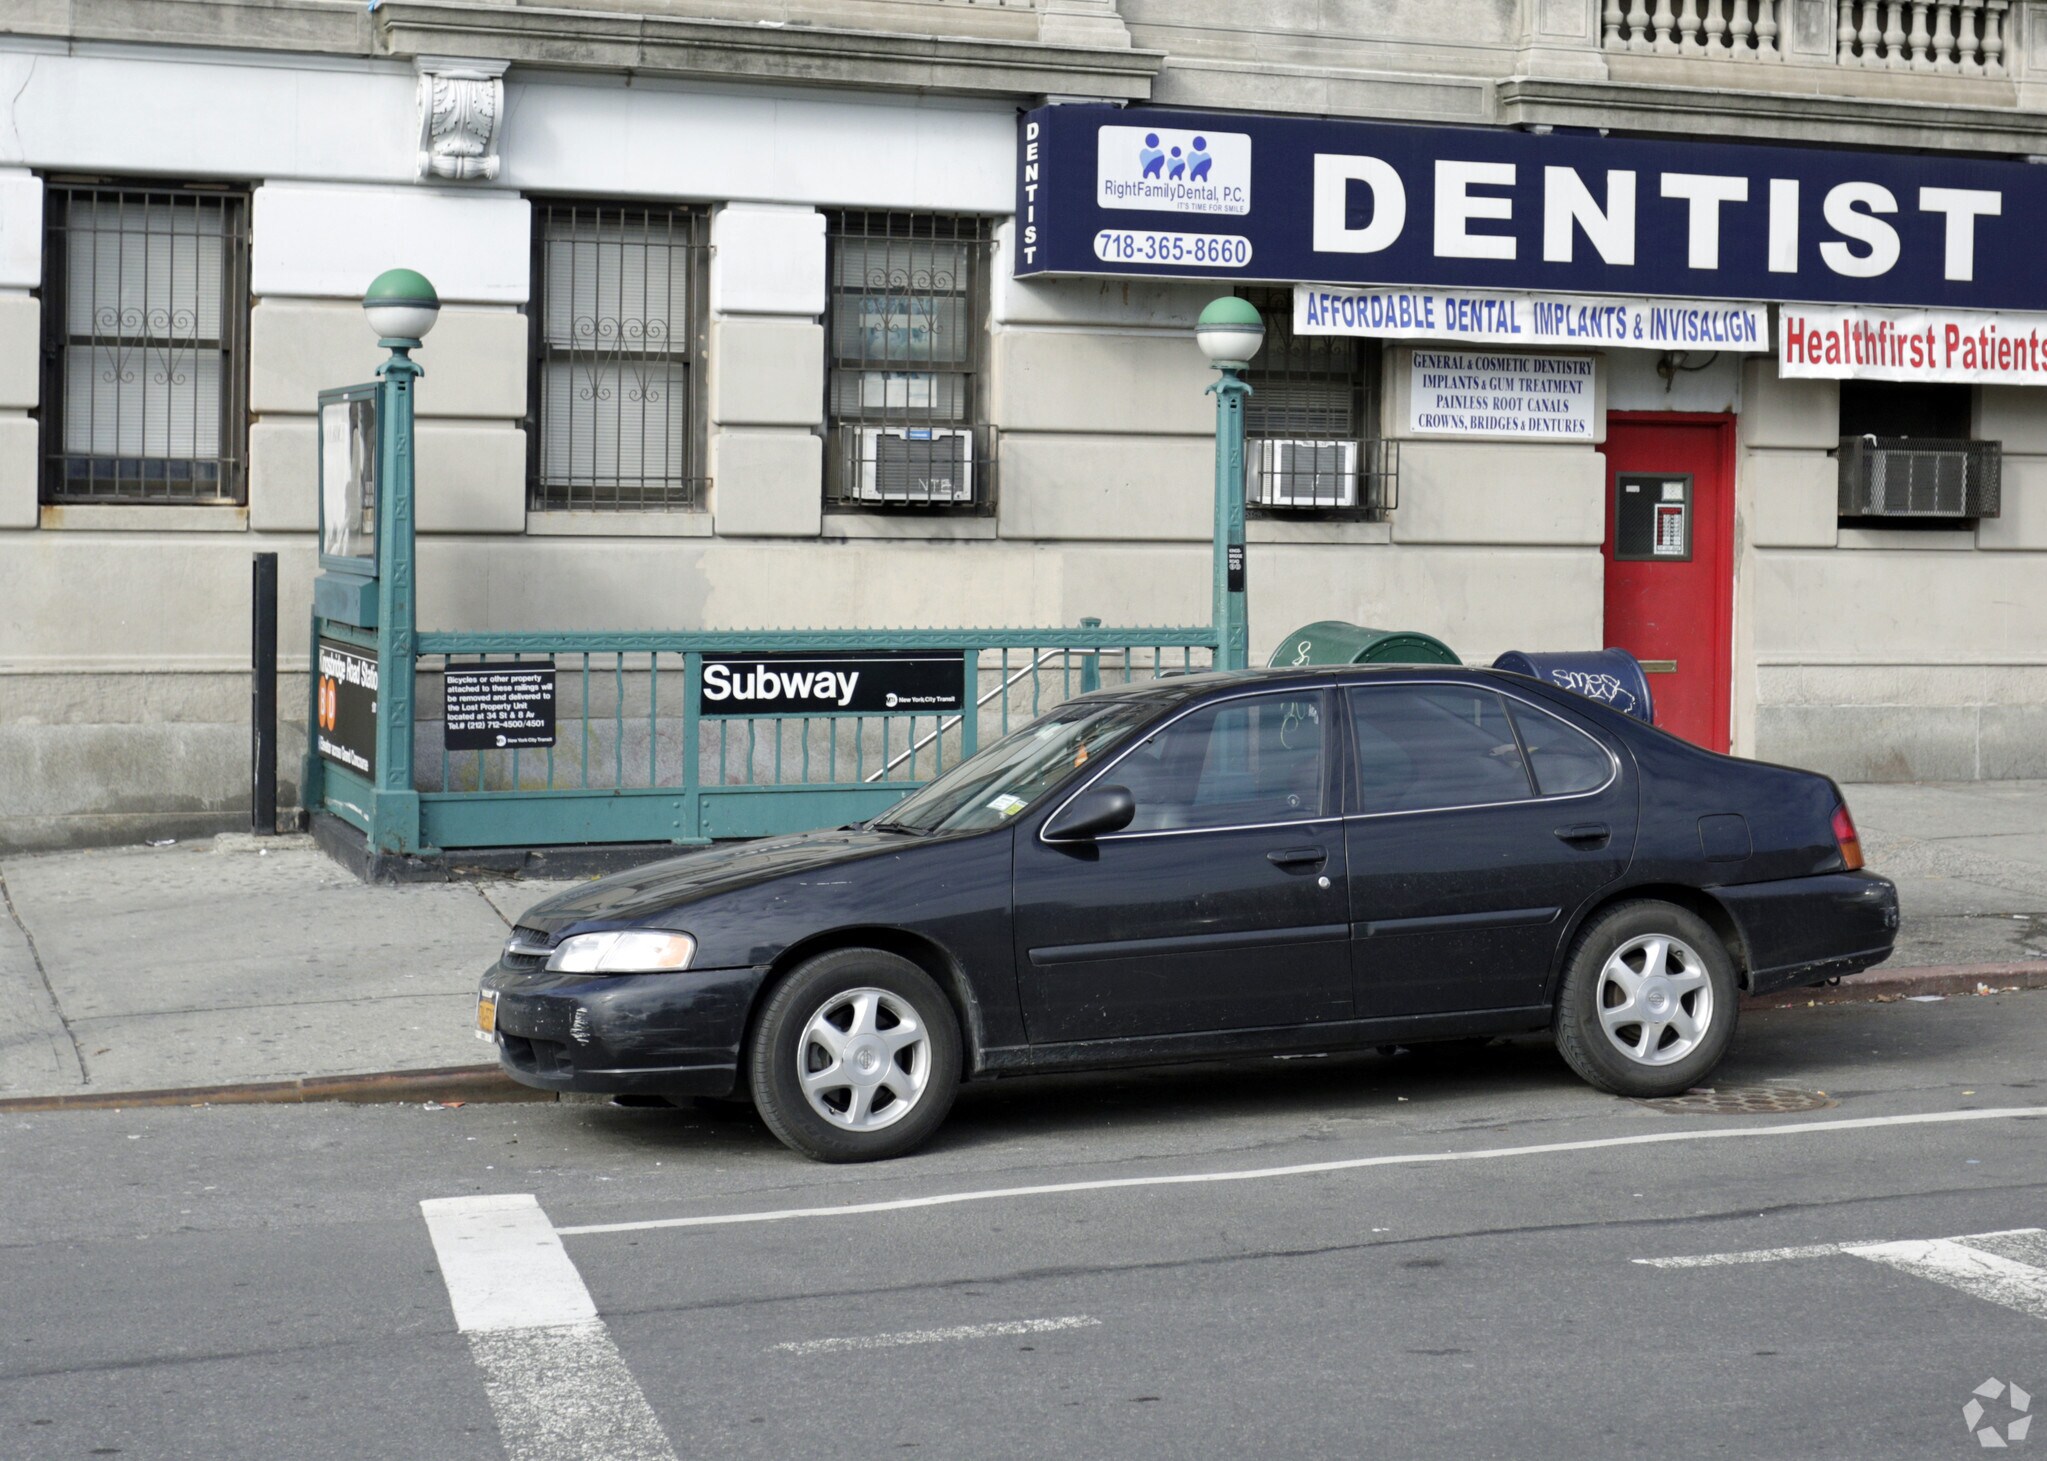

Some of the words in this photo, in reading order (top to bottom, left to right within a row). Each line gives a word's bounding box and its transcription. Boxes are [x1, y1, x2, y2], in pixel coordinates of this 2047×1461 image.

[1024, 122, 1040, 265] DENTIST
[1105, 179, 1219, 202] RightFamilyDental,
[1223, 186, 1245, 203] P.C.
[1177, 202, 1190, 210] IT'S
[1191, 203, 1207, 211] TIME
[1208, 204, 1222, 212] FOR
[1224, 204, 1244, 213] SMILE
[1313, 153, 2002, 282] DENTIST
[1100, 233, 1246, 263] 718-365-8660
[1307, 292, 1435, 329] AFFORDABLE
[1445, 298, 1522, 334] DENTAL
[1533, 302, 1627, 340] IMPLANTS
[1633, 313, 1643, 340] &
[1650, 307, 1757, 342] INVISALIGN
[1787, 317, 1937, 369] Healthfirst
[1413, 353, 1466, 370] GENERAL
[1467, 359, 1473, 370] &
[1475, 356, 1530, 373] COSMETIC
[1534, 359, 1594, 376] DENTISTRY
[1423, 374, 1479, 390] IMPLANTS
[1481, 380, 1487, 390] &
[1489, 376, 1514, 391] GUM
[1519, 378, 1583, 394] TREATMENT
[1436, 394, 1488, 410] PAINLESS
[1493, 397, 1524, 412] ROOT
[1528, 398, 1569, 413] CANALS
[1418, 413, 1468, 431] CROWNS,
[1470, 415, 1519, 431] BRIDGES
[1520, 420, 1526, 431] &
[1528, 417, 1585, 433] DENTURES
[361, 660, 379, 691] Statio
[447, 676, 478, 685] Bicycles
[490, 675, 509, 683] other
[511, 674, 542, 683] property
[703, 664, 860, 707] Subway
[447, 685, 480, 693] attached
[482, 684, 490, 692] to
[492, 684, 512, 692] these
[514, 683, 539, 692] railings
[541, 682, 553, 691] will
[447, 694, 457, 702] be
[459, 693, 491, 702] removed
[492, 693, 507, 701] and
[508, 692, 541, 701] delivered
[542, 692, 551, 700] to
[447, 703, 460, 711] the
[461, 703, 478, 711] Lost
[480, 702, 511, 711] Property
[513, 701, 528, 710] Unit
[447, 712, 475, 721] located
[476, 712, 485, 720] at
[486, 711, 497, 720] 34
[499, 711, 508, 719] St
[525, 711, 535, 719] Av
[467, 721, 486, 730] (212)
[487, 720, 545, 729] 712-4500/4501
